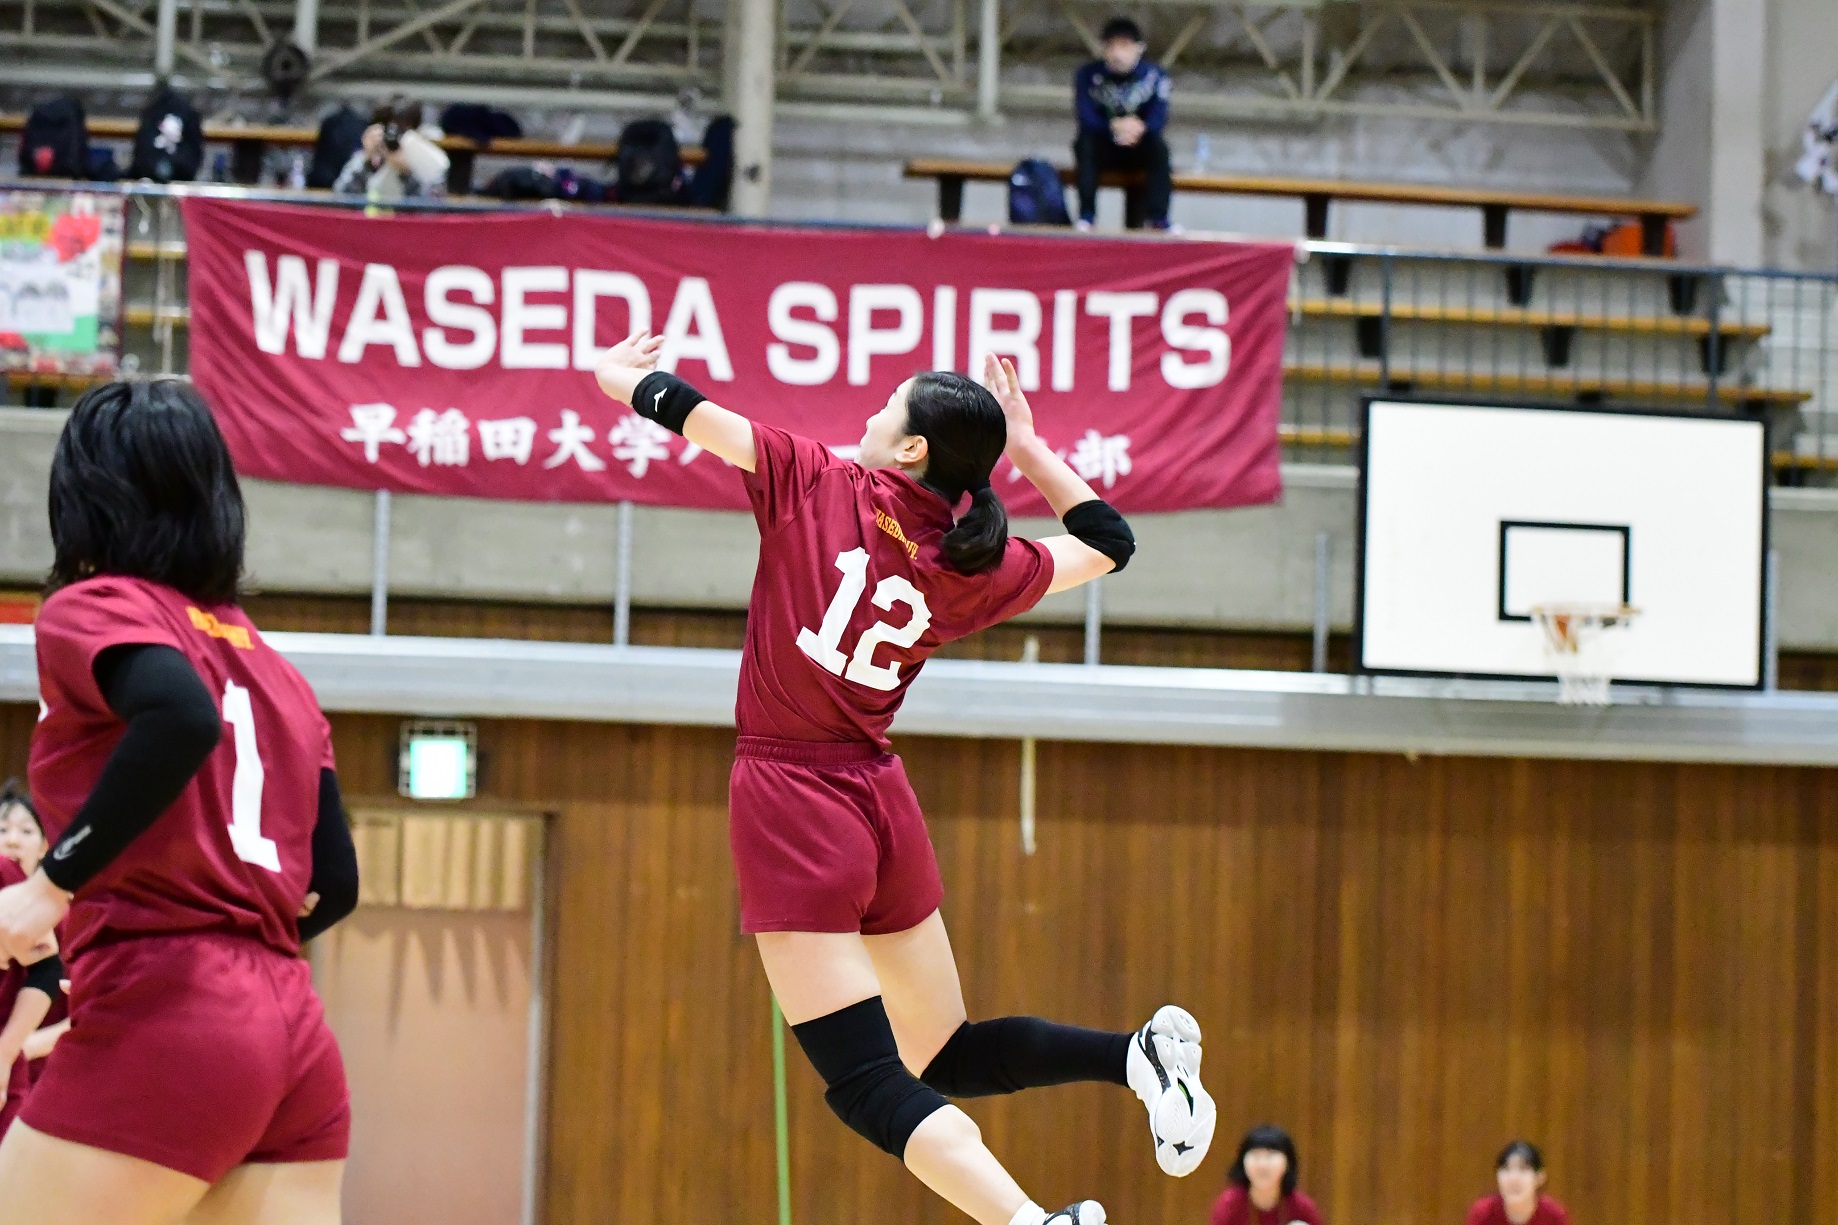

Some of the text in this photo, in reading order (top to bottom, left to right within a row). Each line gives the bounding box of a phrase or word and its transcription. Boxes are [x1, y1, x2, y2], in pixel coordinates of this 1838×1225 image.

[246, 250, 1232, 392] WASEDA SPIRITS
[795, 546, 932, 691] 12
[222, 678, 282, 873] 1
